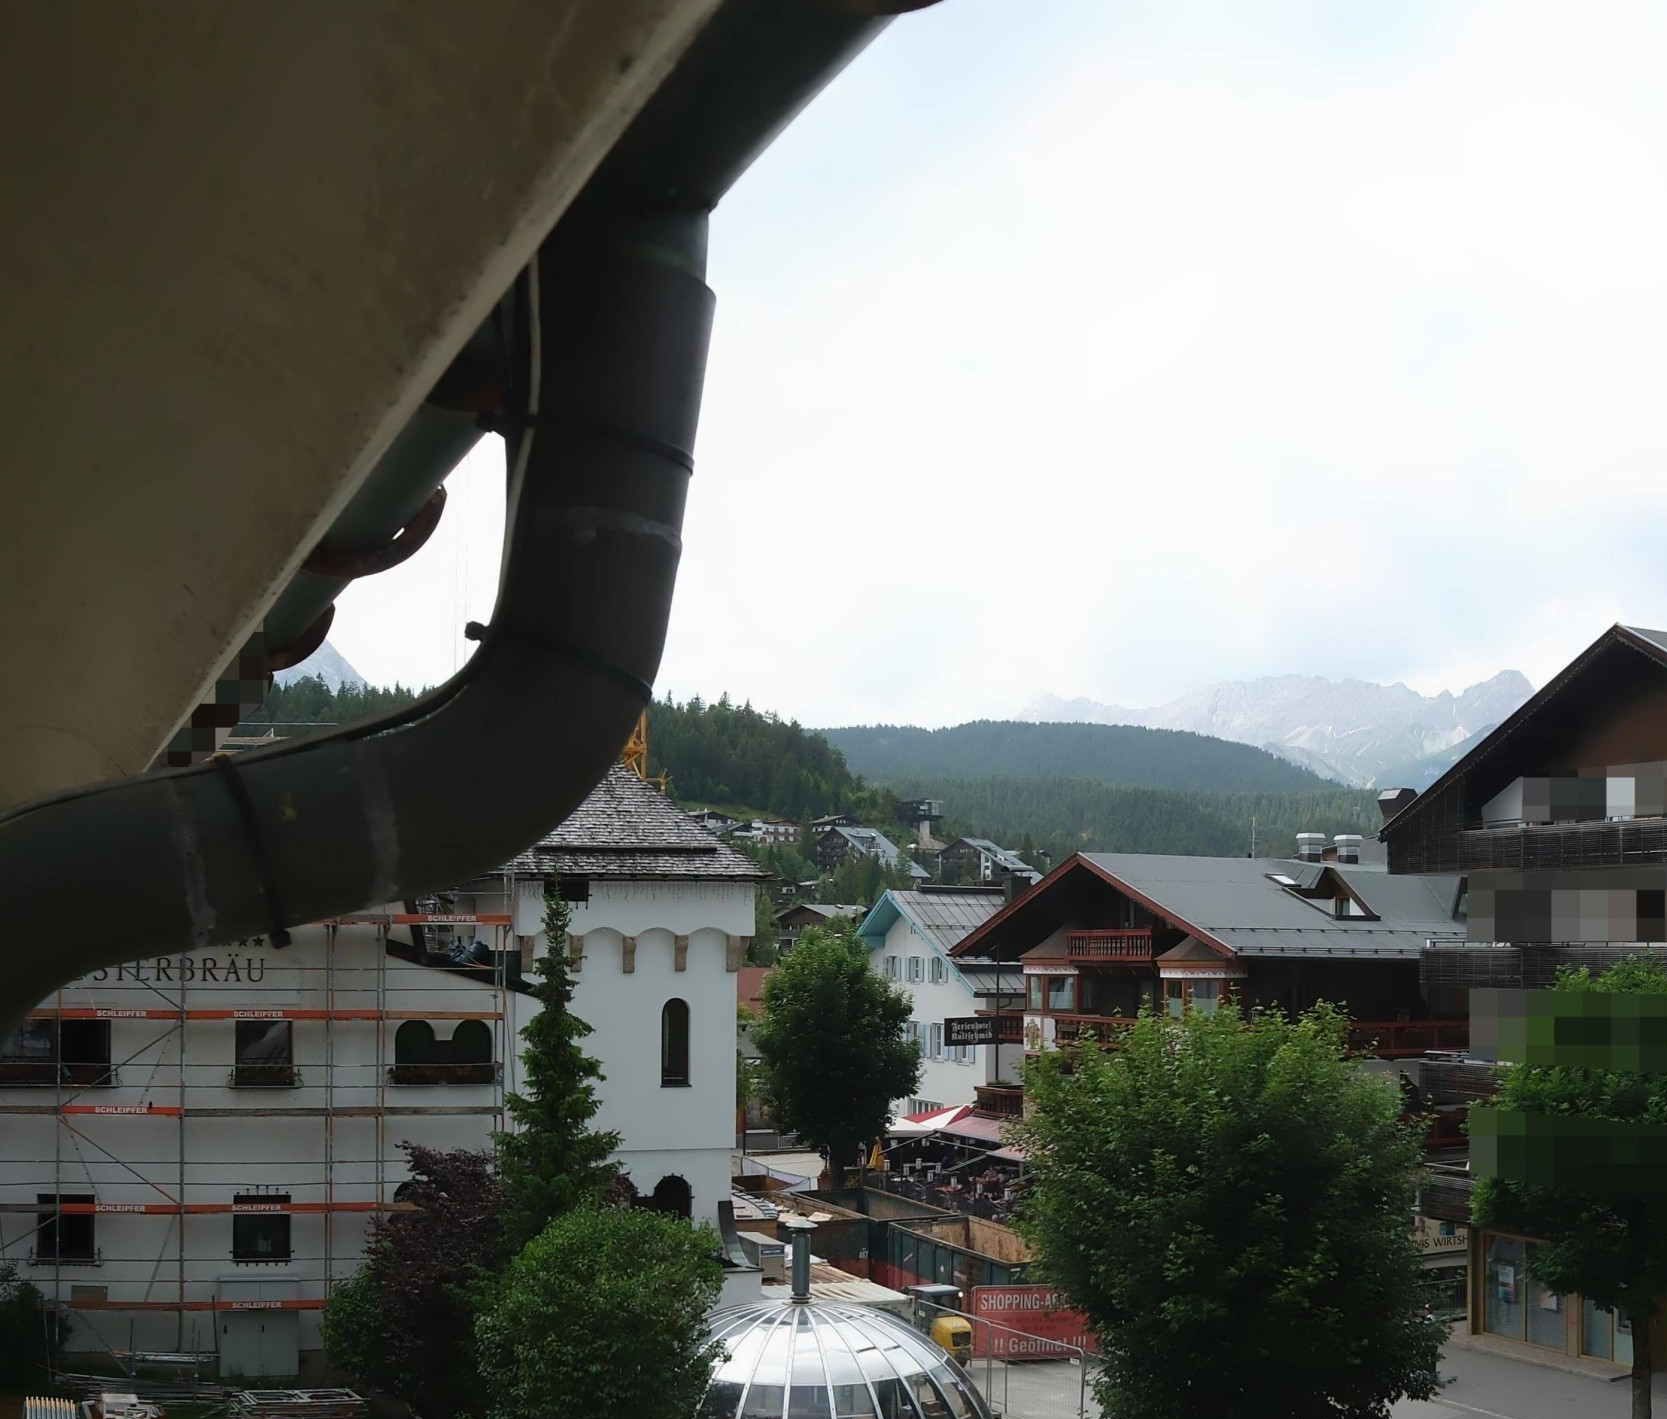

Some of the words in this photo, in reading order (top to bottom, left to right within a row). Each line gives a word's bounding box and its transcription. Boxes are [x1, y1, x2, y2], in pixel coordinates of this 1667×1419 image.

[96, 1010, 148, 1018] SCHLEIPFER
[233, 1010, 284, 1018] SCHLEIPFER
[95, 1105, 148, 1114] SCHLEIPFER
[95, 1204, 146, 1212] SCHLEIPFER
[231, 1203, 282, 1211] SCHLEIPFER
[231, 1301, 283, 1309] SCHLEIPFER
